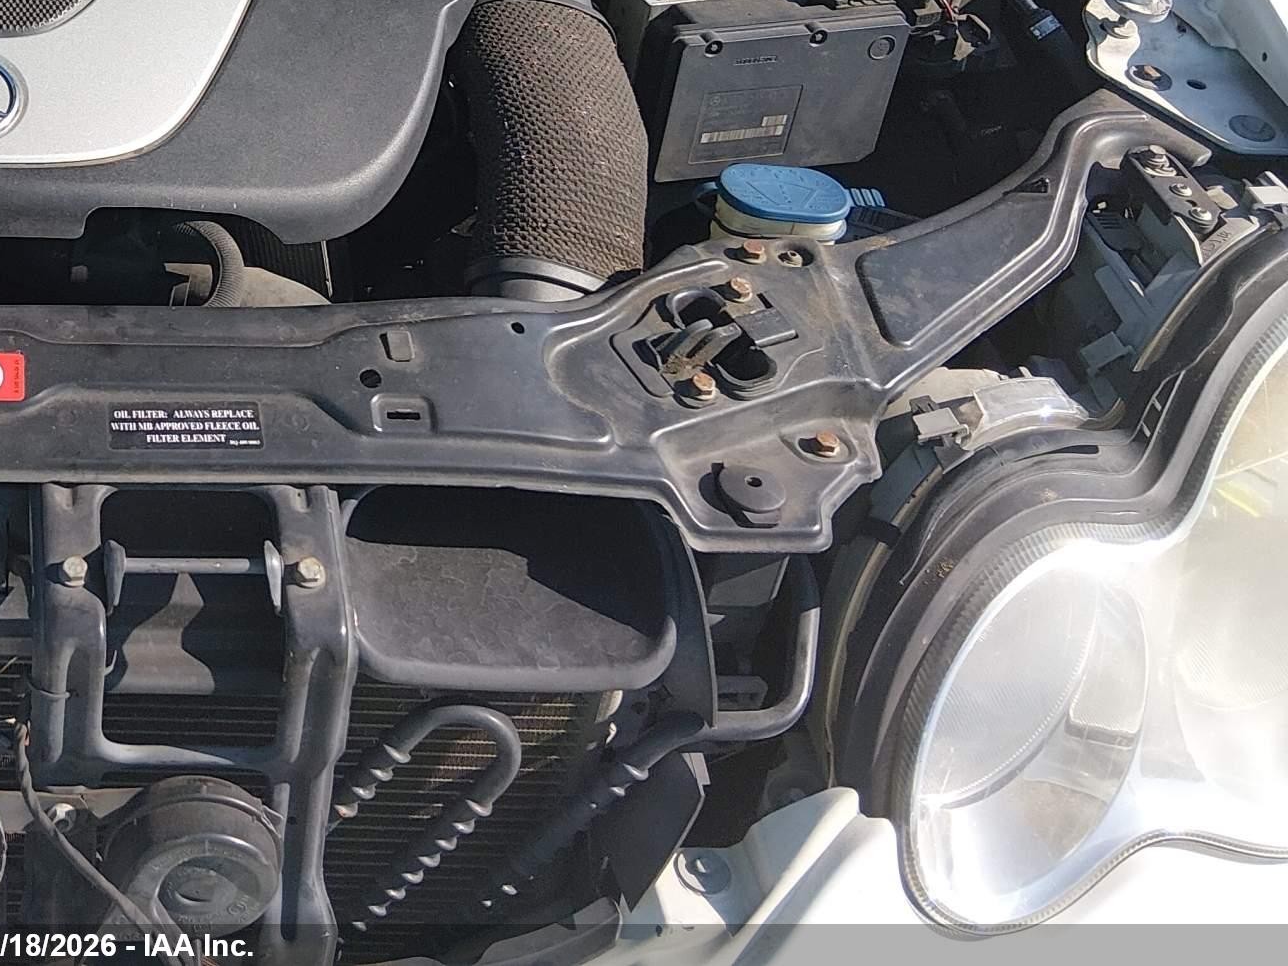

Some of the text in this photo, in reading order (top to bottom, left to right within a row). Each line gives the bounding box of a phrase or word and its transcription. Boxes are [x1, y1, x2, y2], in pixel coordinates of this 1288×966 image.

[113, 409, 255, 419] OIL FILTER: ALWAYS REPLACE
[111, 421, 260, 431] WITH MB APPROVED FLEECE OIL
[146, 433, 180, 443] FILTER
[181, 433, 227, 443] ELEMENT
